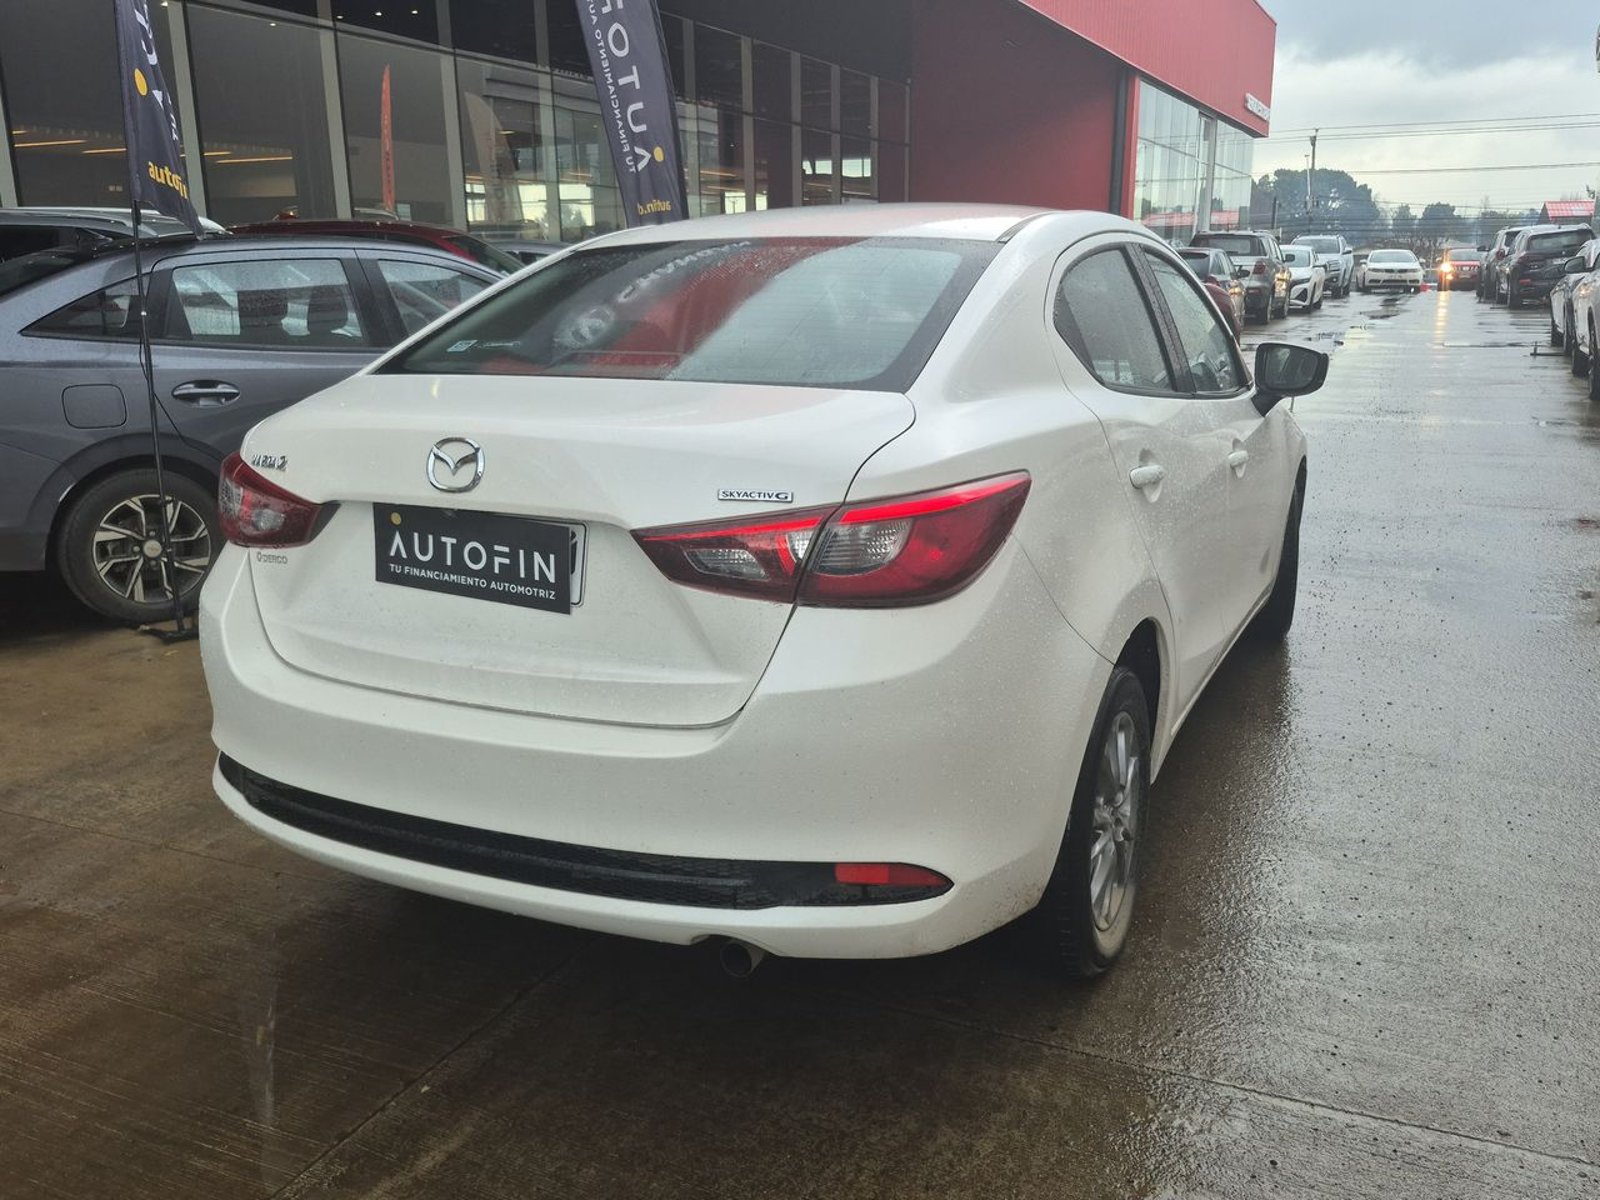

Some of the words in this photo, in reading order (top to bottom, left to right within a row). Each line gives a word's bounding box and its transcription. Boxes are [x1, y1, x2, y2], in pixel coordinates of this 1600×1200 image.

[389, 530, 556, 583] AUTOFIN
[389, 563, 402, 574] TU
[404, 567, 488, 589] FINANCIAMIENTO
[489, 580, 557, 600] AUTOMOTRIZ
